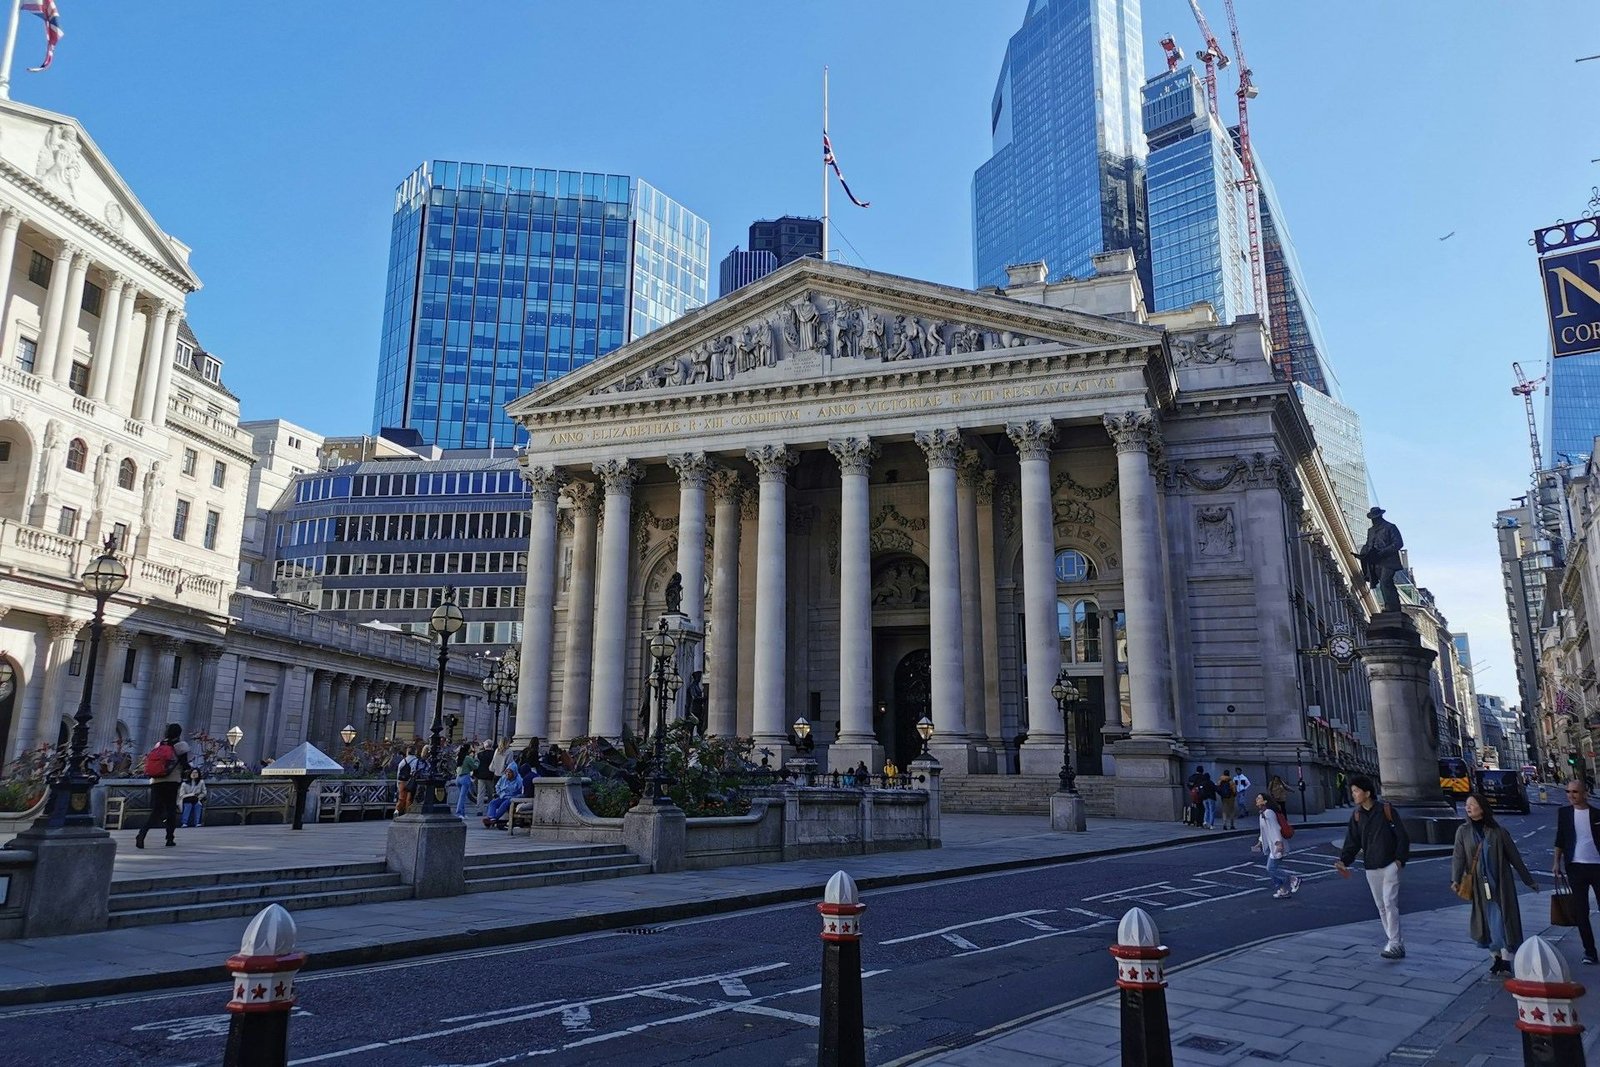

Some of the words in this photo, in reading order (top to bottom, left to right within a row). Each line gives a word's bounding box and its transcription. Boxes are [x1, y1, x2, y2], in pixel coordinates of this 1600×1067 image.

[548, 432, 584, 445] ANNO
[688, 421, 696, 431] R
[704, 416, 724, 429] XIII
[731, 409, 800, 426] CONDITVM
[817, 403, 857, 418] ANNO
[951, 391, 961, 405] R
[1002, 377, 1117, 399] RESTAVRATVM
